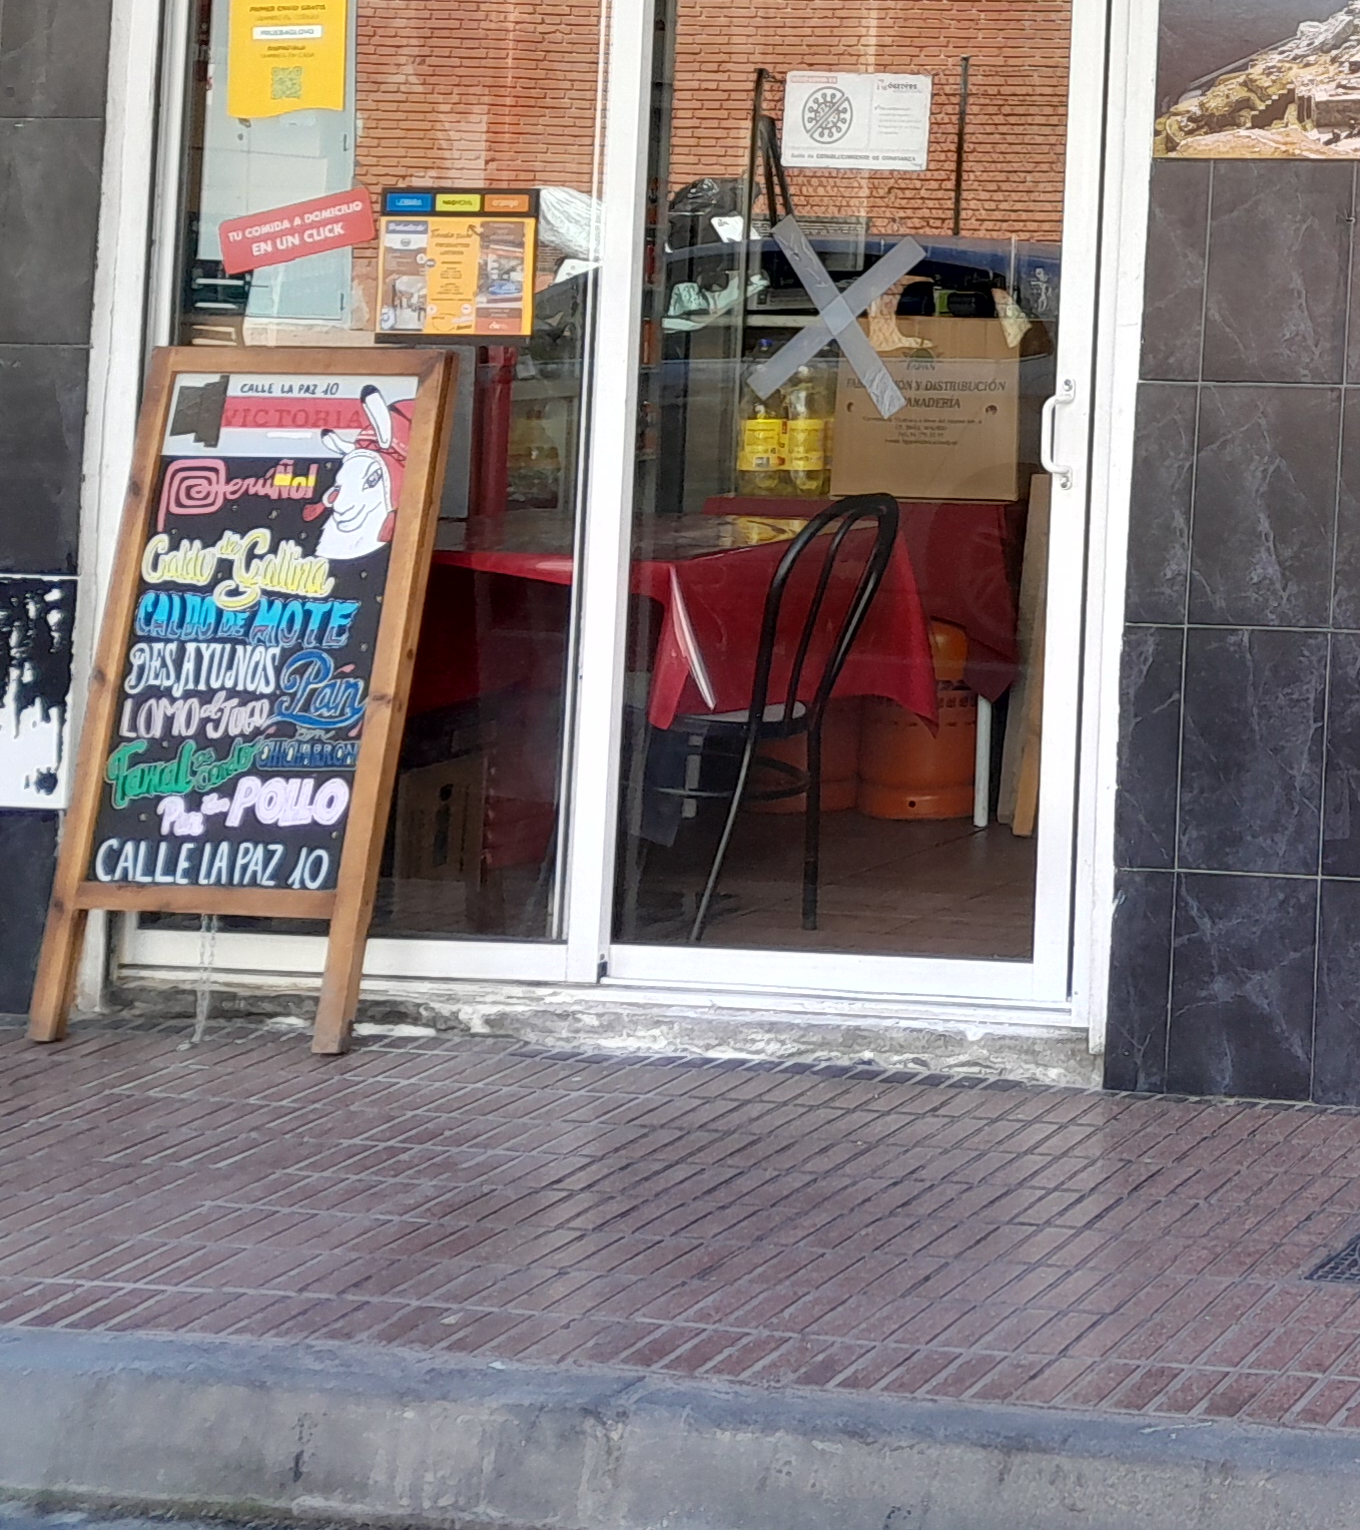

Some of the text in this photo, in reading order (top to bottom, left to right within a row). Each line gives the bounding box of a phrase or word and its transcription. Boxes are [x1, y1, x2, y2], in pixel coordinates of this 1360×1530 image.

[228, 201, 363, 243] TU COMIDA A DOMICILIO
[251, 221, 346, 256] EN UN CLICK
[240, 382, 340, 396] CALLE LA PAZ 10
[222, 407, 363, 428] VICTORIA
[135, 590, 361, 649] CALDO DE MOTE
[119, 698, 198, 738] LOMO
[225, 775, 350, 828] POLLO
[95, 838, 330, 890] CALLE LA PAZ 10
